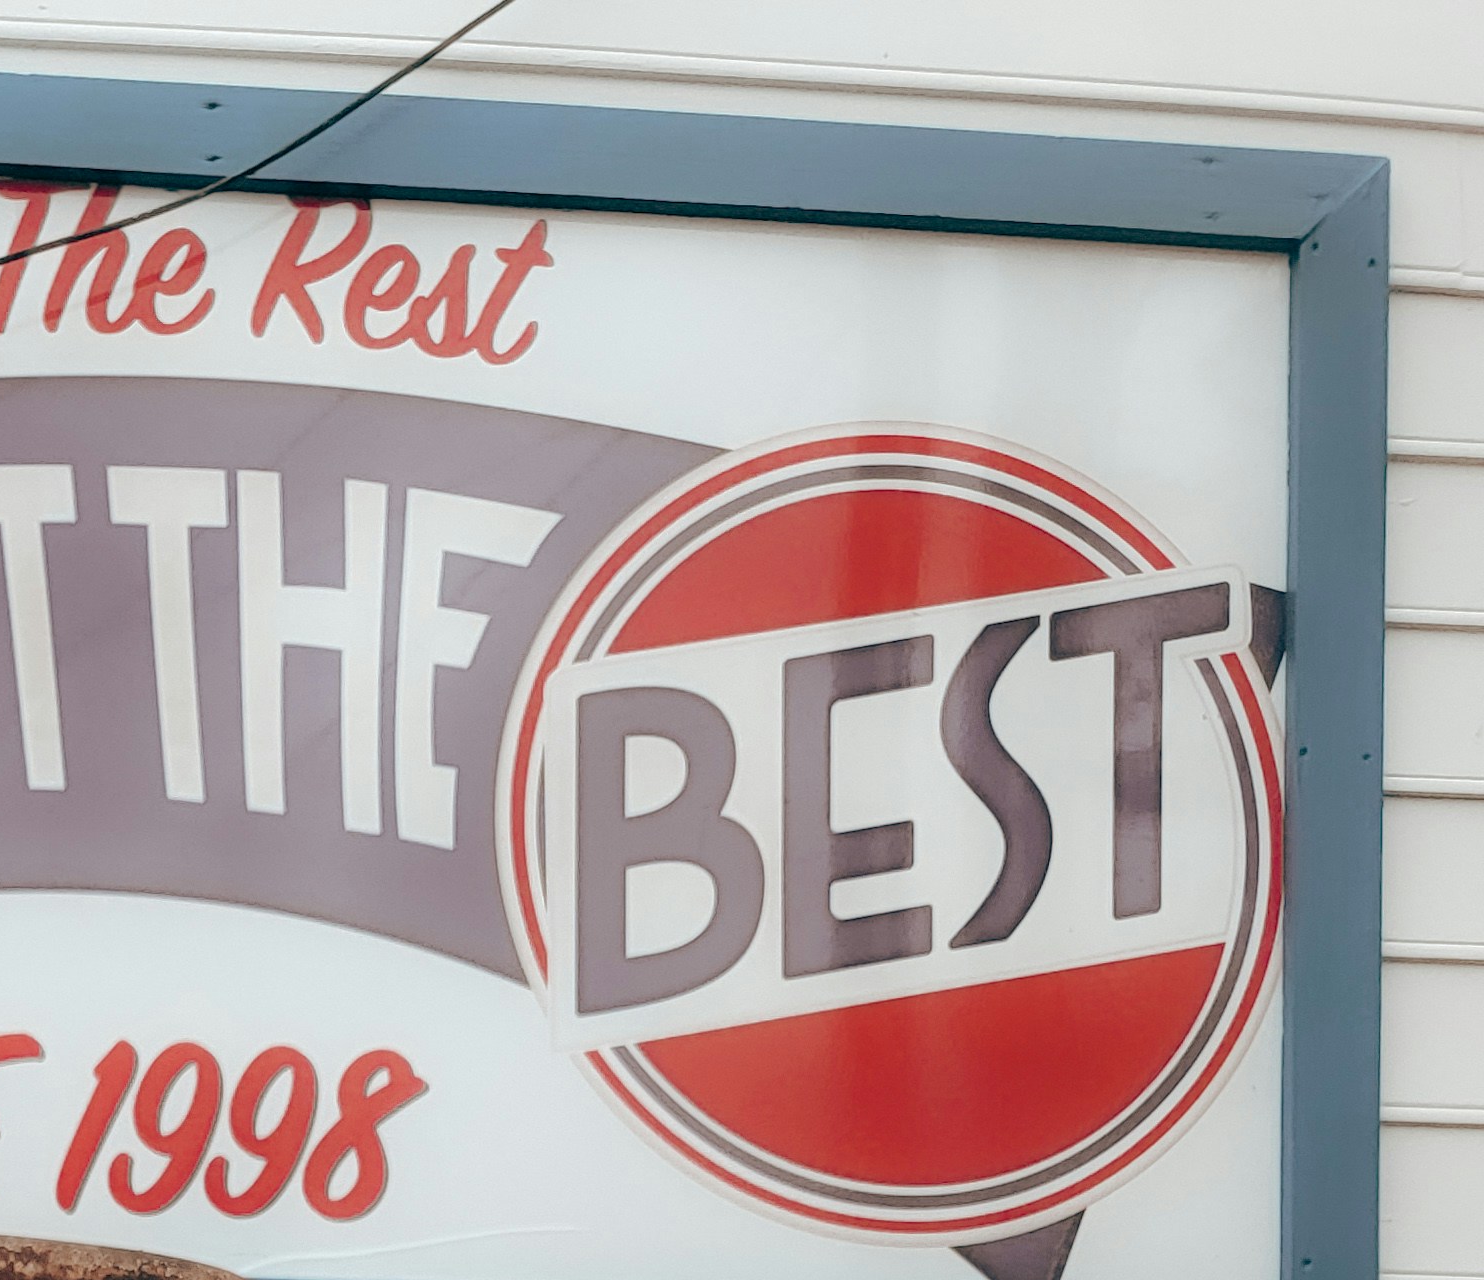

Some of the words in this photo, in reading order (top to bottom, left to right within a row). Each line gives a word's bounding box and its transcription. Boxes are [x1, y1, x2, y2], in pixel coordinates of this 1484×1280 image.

[250, 197, 556, 364] Rest
[107, 464, 564, 850] THE
[576, 582, 1231, 1018] BEST
[57, 1039, 429, 1219] 1998
